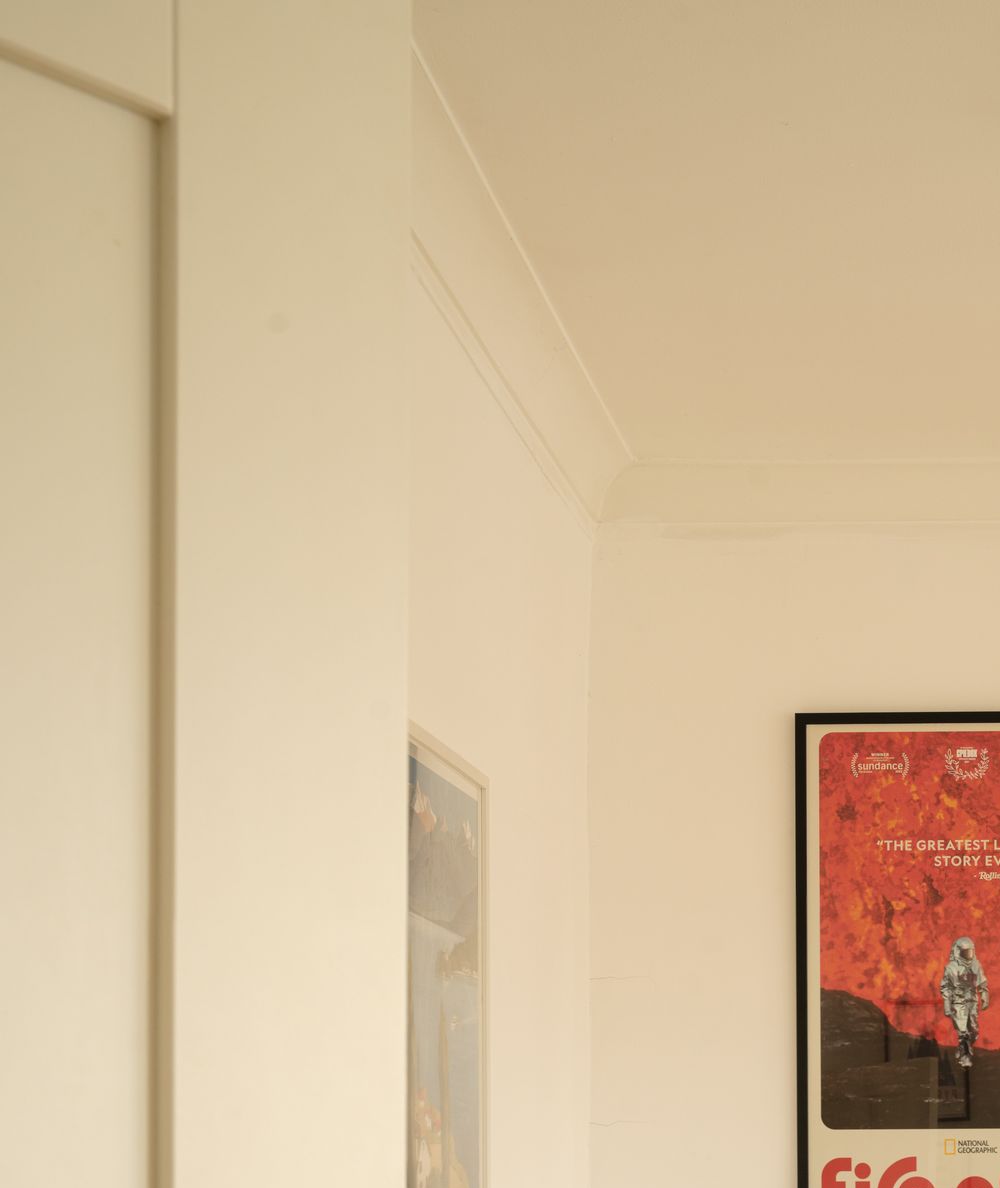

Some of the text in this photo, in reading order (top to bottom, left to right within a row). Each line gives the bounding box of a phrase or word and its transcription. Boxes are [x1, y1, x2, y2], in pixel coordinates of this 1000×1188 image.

[857, 762, 904, 770] sundance
[916, 839, 989, 851] GREATEST
[934, 855, 981, 867] STORY
[957, 1146, 998, 1154] GEOGRAPHIC
